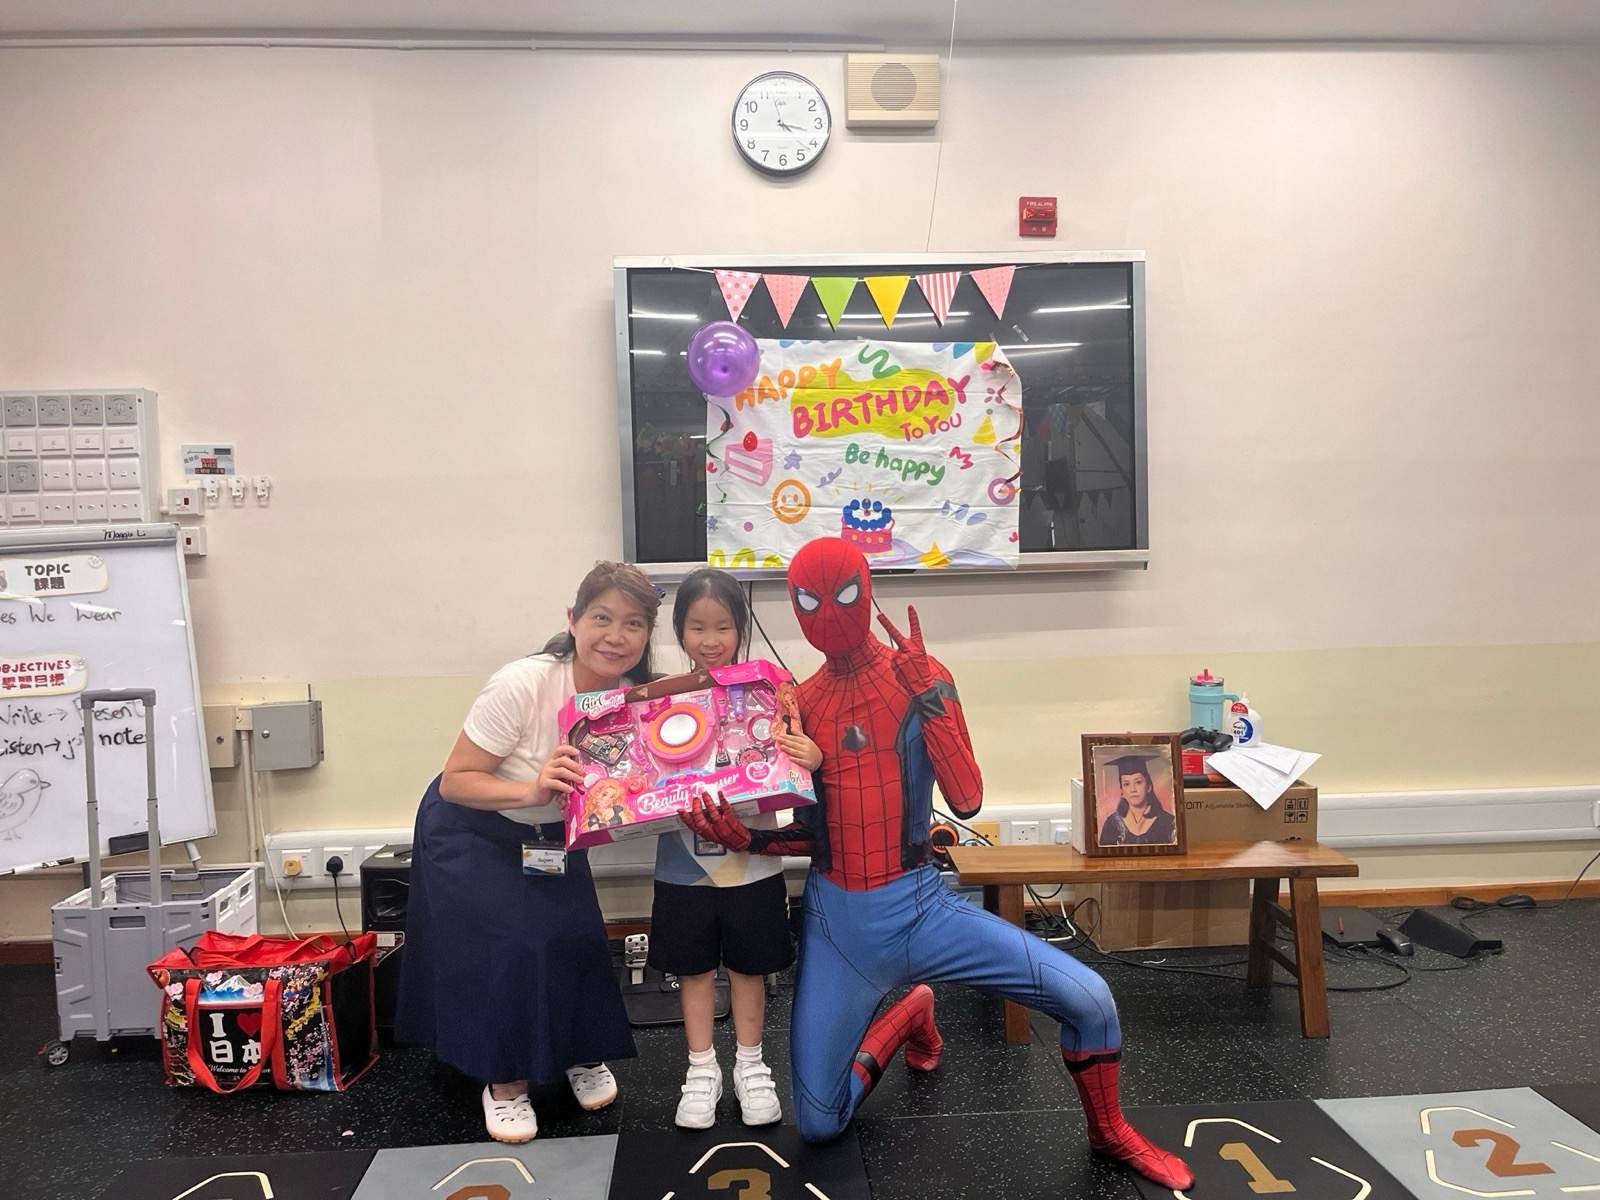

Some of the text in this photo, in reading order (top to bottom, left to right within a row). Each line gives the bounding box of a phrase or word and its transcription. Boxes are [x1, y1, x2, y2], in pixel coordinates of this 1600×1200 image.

[744, 100, 758, 113] 10
[807, 99, 817, 112] 2
[740, 119, 749, 131] 9
[814, 117, 823, 130] 3
[747, 137, 756, 150] 8
[809, 138, 818, 148] 4
[761, 149, 770, 162] 7
[779, 154, 788, 166] 6
[796, 149, 806, 161] 5
[735, 358, 842, 411] HAPPY
[792, 375, 970, 438] BIRTHDAY
[845, 442, 946, 486] Be happy
[24, 563, 71, 576] TOPIC
[34, 576, 65, 591] 課題
[29, 602, 56, 623] We
[638, 784, 690, 812] Beauty
[209, 1012, 227, 1037] I
[209, 1039, 261, 1064] 日本
[1452, 1128, 1557, 1178] 2
[1218, 1142, 1297, 1194] 1
